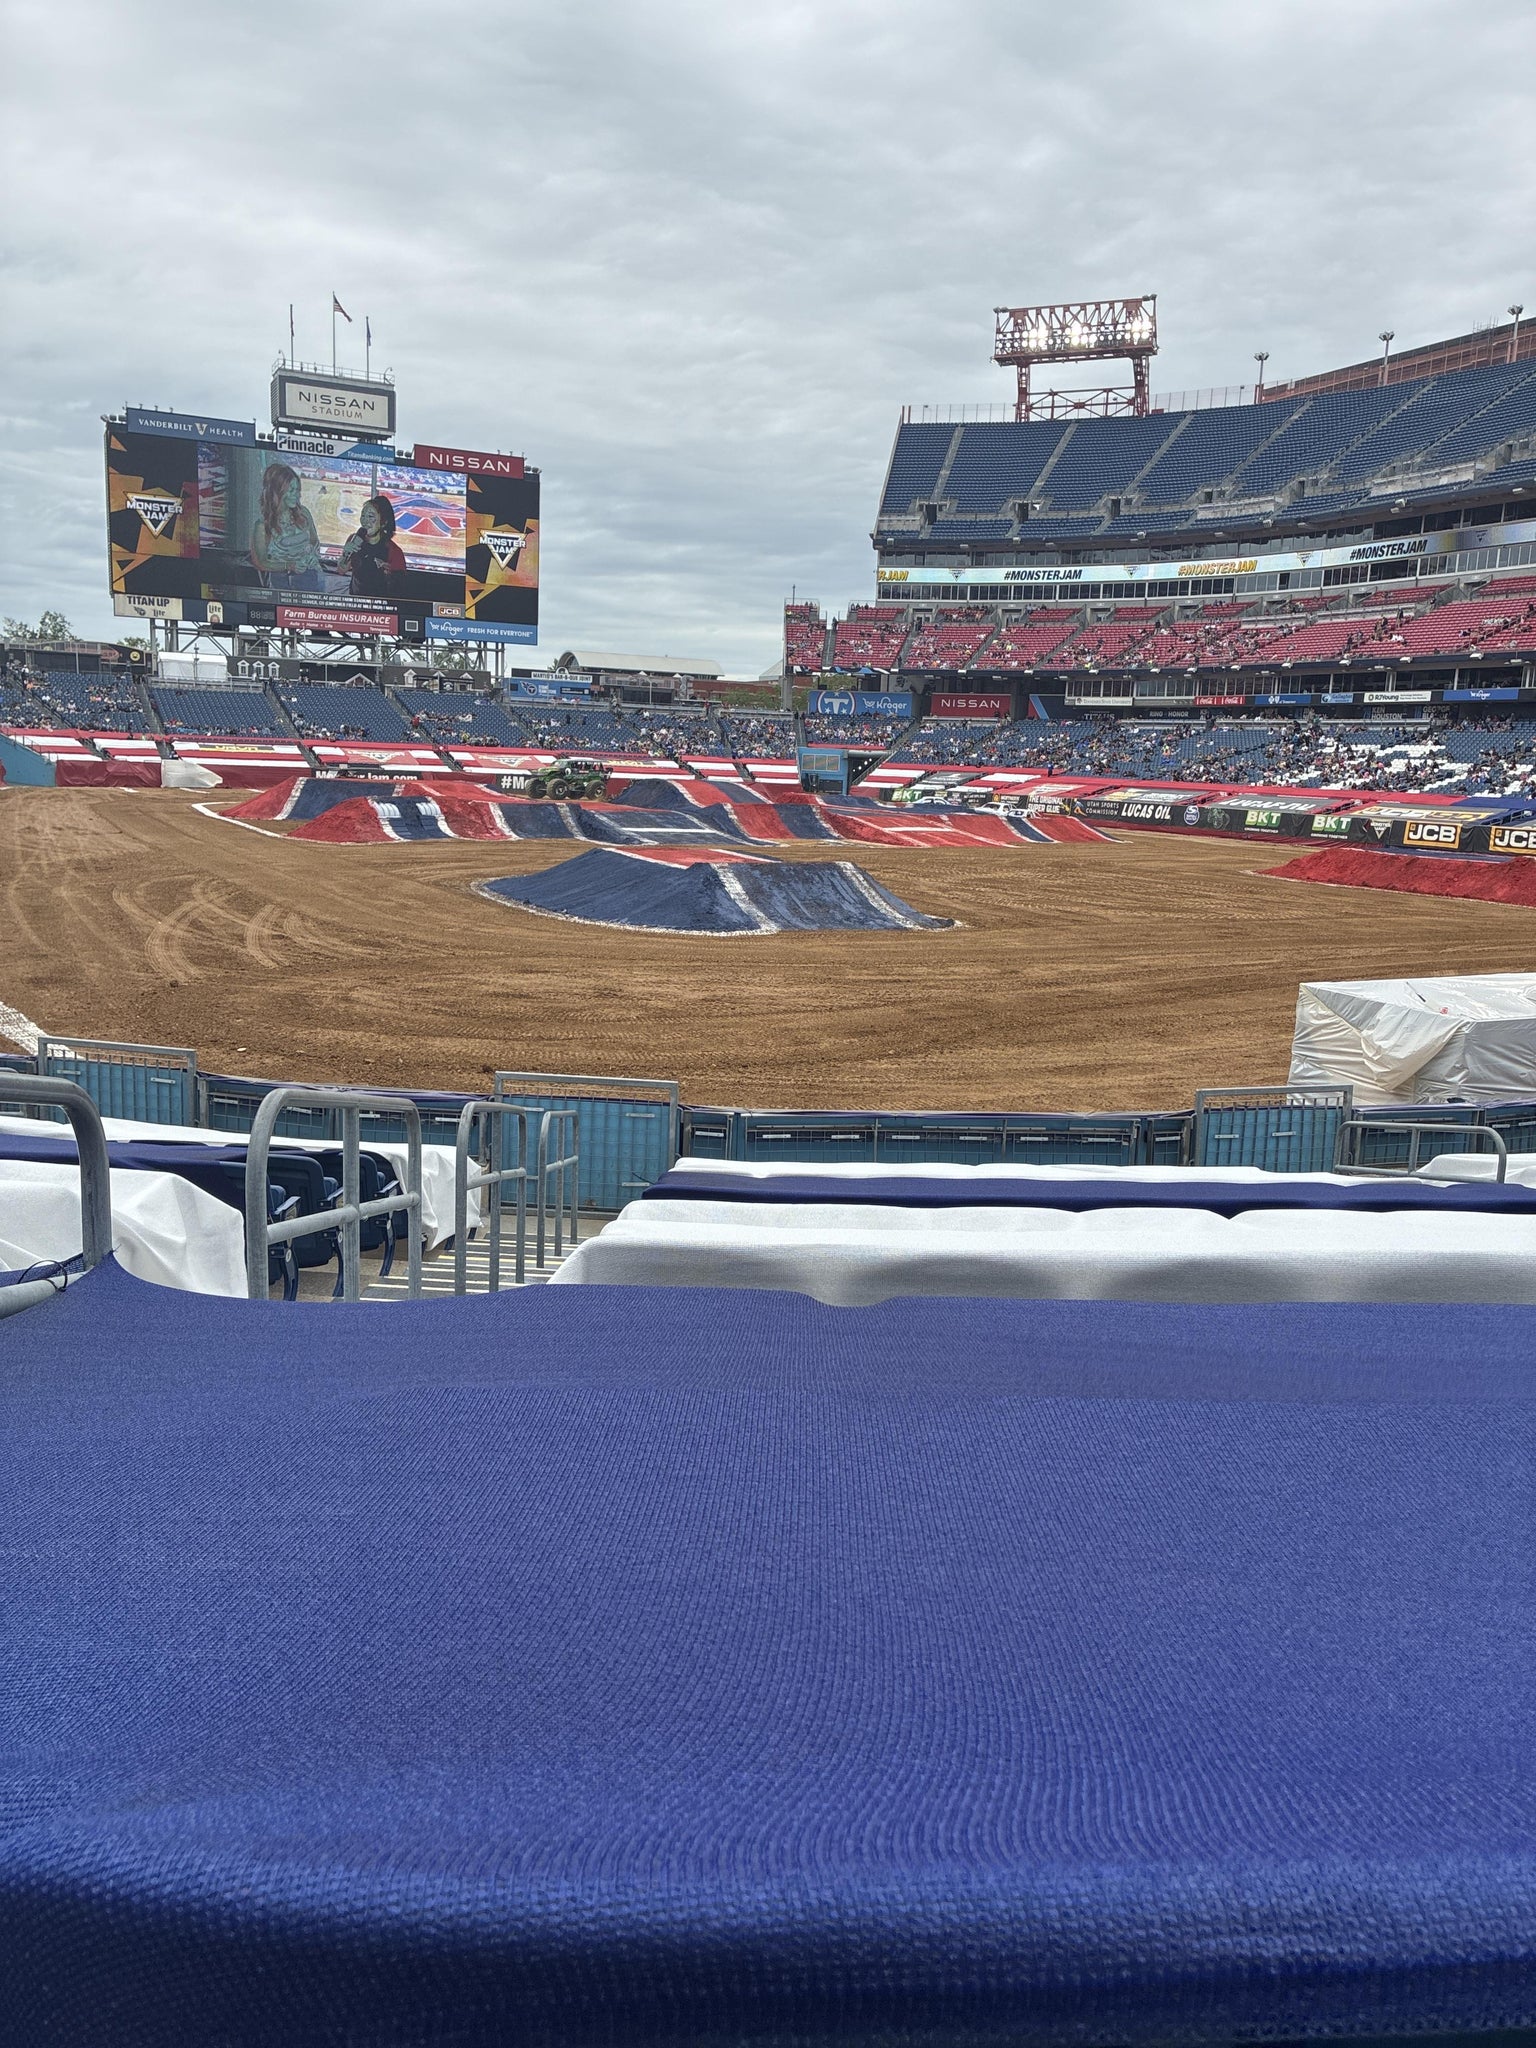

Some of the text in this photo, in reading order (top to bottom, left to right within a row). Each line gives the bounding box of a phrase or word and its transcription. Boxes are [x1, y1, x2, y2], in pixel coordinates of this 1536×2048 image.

[298, 391, 375, 411] NISSAN
[311, 405, 363, 419] STADIUM
[138, 418, 193, 431] VANDERBILT
[209, 427, 243, 438] HEALTH
[278, 434, 334, 455] Pinnacle
[429, 452, 511, 473] NISSAN
[126, 500, 183, 514] MONSTER
[143, 510, 168, 521] JAM
[479, 536, 526, 548] MONSTER
[493, 545, 513, 554] JAM
[1350, 539, 1428, 561] #MONSTERJAM
[1178, 560, 1257, 576] #MONSTERJAM
[1003, 569, 1083, 581] #MONSTERJAM
[127, 596, 170, 607] TITAN UP
[208, 604, 222, 614] Lite
[440, 607, 460, 615] JCB
[284, 609, 306, 619] Farm
[307, 611, 337, 621] Bureau
[339, 614, 391, 625] INSURANCE
[441, 622, 463, 636] Kroger
[486, 628, 499, 636] FOR
[941, 698, 1000, 709] NISSAN
[1371, 713, 1403, 721] HOUSTON
[892, 790, 921, 801] BKT
[1028, 795, 1039, 804] THE
[1039, 796, 1063, 805] ORIGINAL
[1028, 804, 1060, 814] SUPER GLUE
[1101, 802, 1119, 810] SPORTS
[1121, 803, 1154, 819] LUCAS
[1154, 805, 1171, 820] OIL
[1085, 809, 1118, 817] COMMISSION
[1246, 811, 1281, 826] BKT
[1313, 816, 1351, 830] BKT
[1408, 824, 1456, 843] JCB
